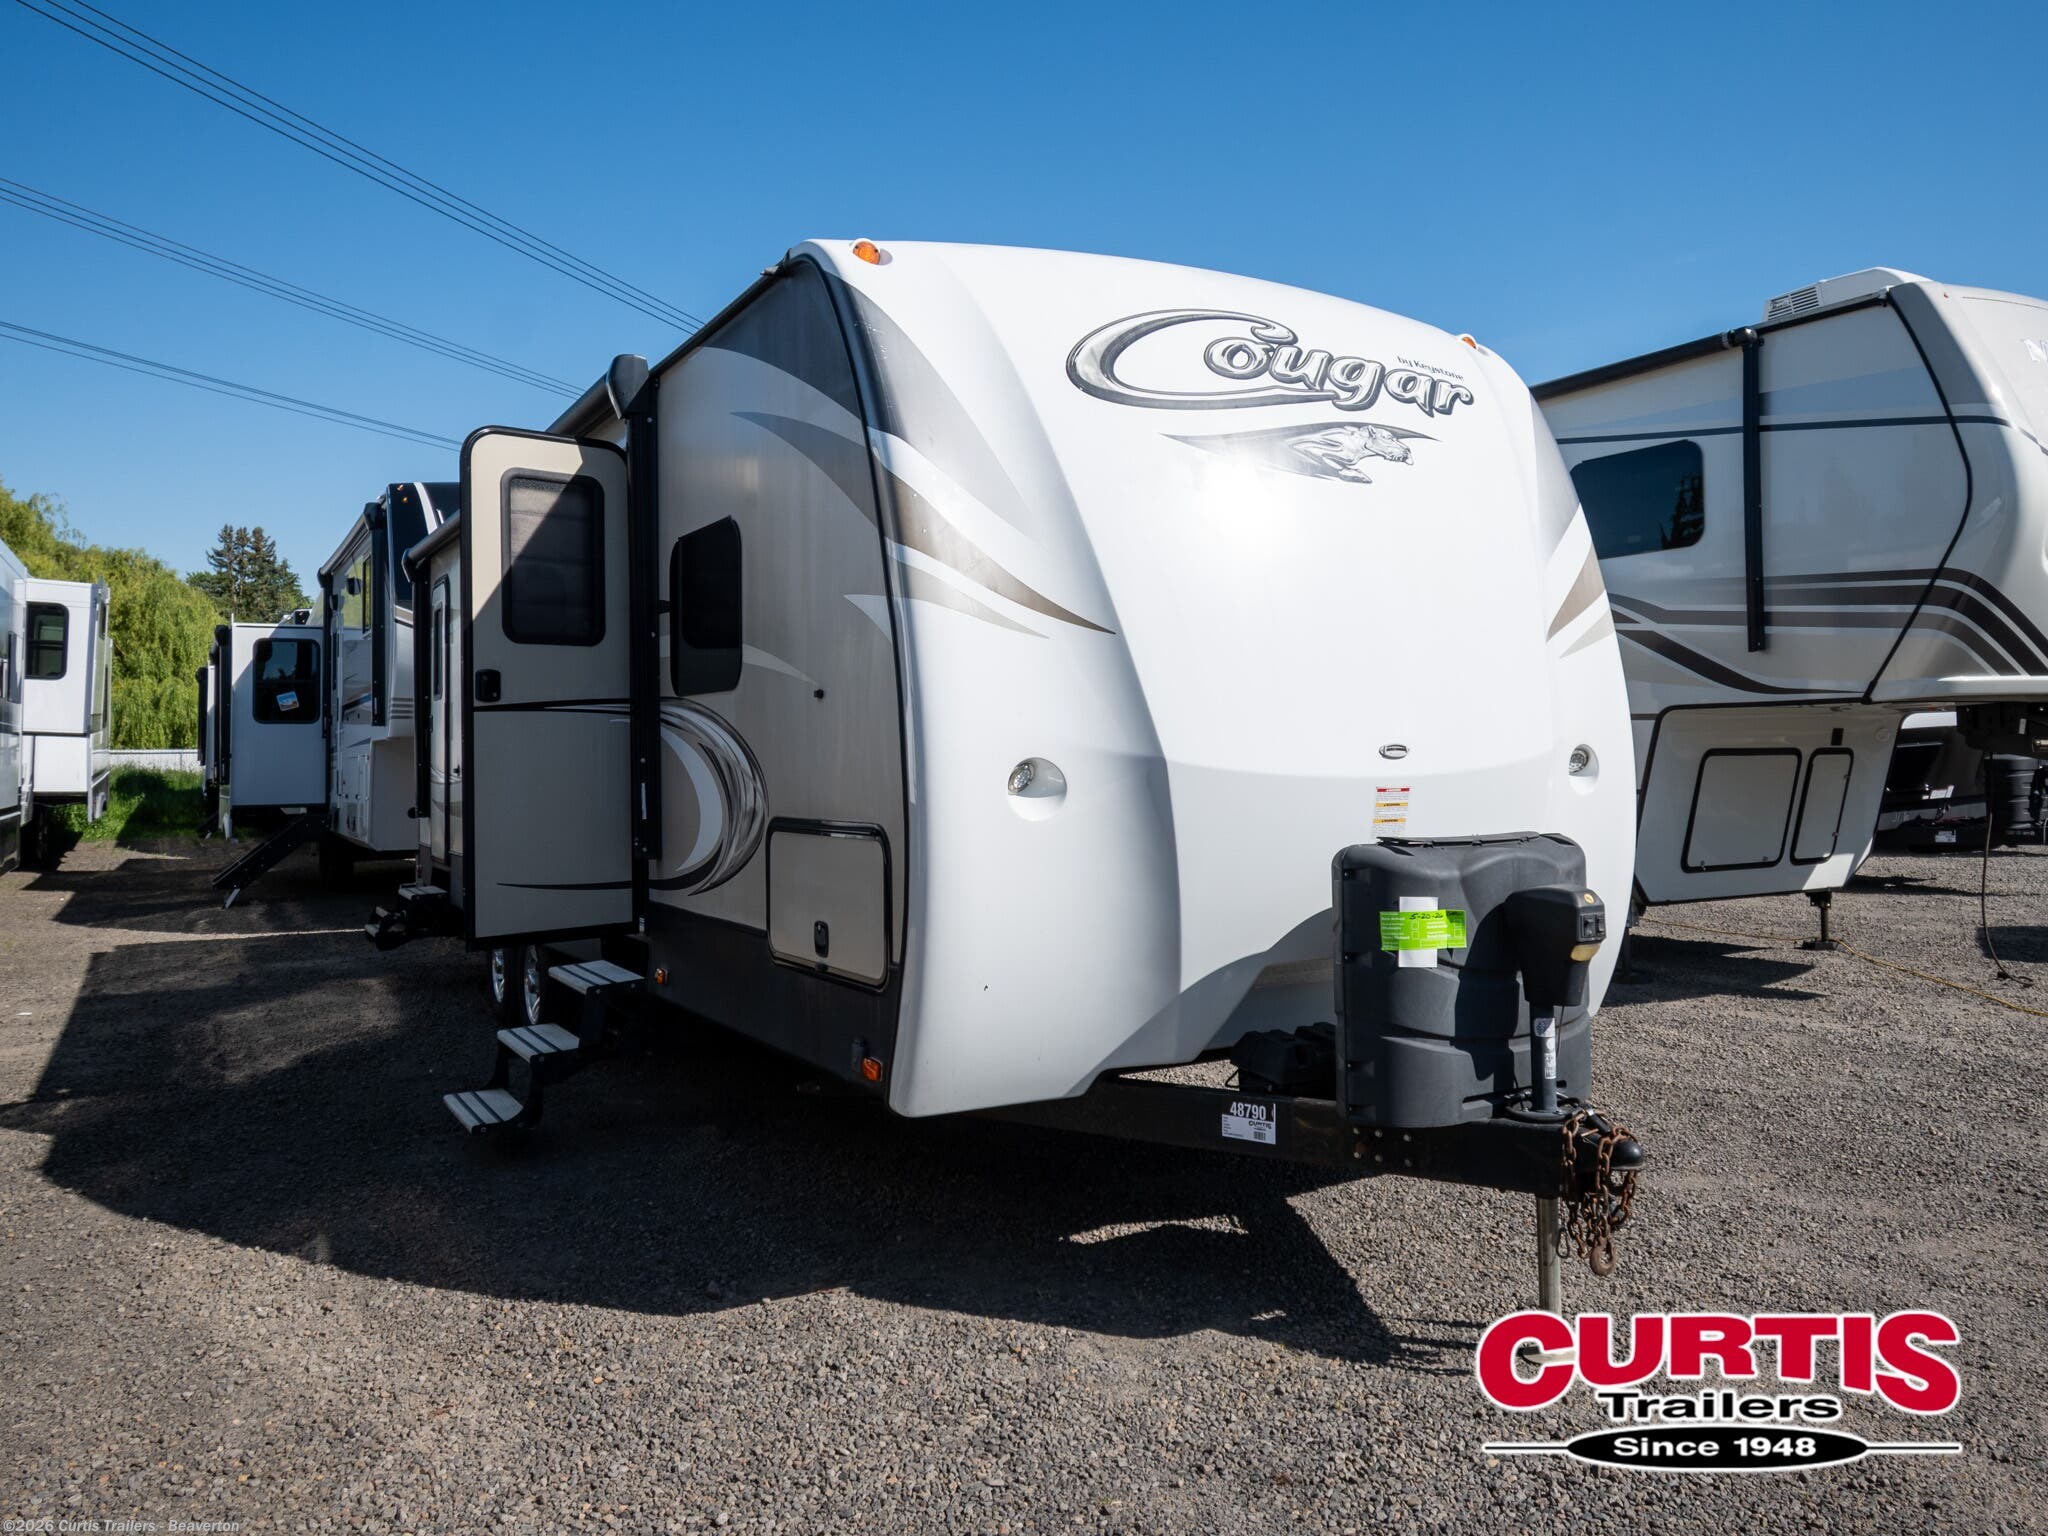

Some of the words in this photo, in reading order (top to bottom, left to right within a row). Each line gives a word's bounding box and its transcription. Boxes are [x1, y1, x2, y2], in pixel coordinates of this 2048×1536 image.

[1066, 308, 1474, 417] Cougar
[1413, 360, 1464, 381] Keystone
[1230, 1101, 1267, 1121] 48790
